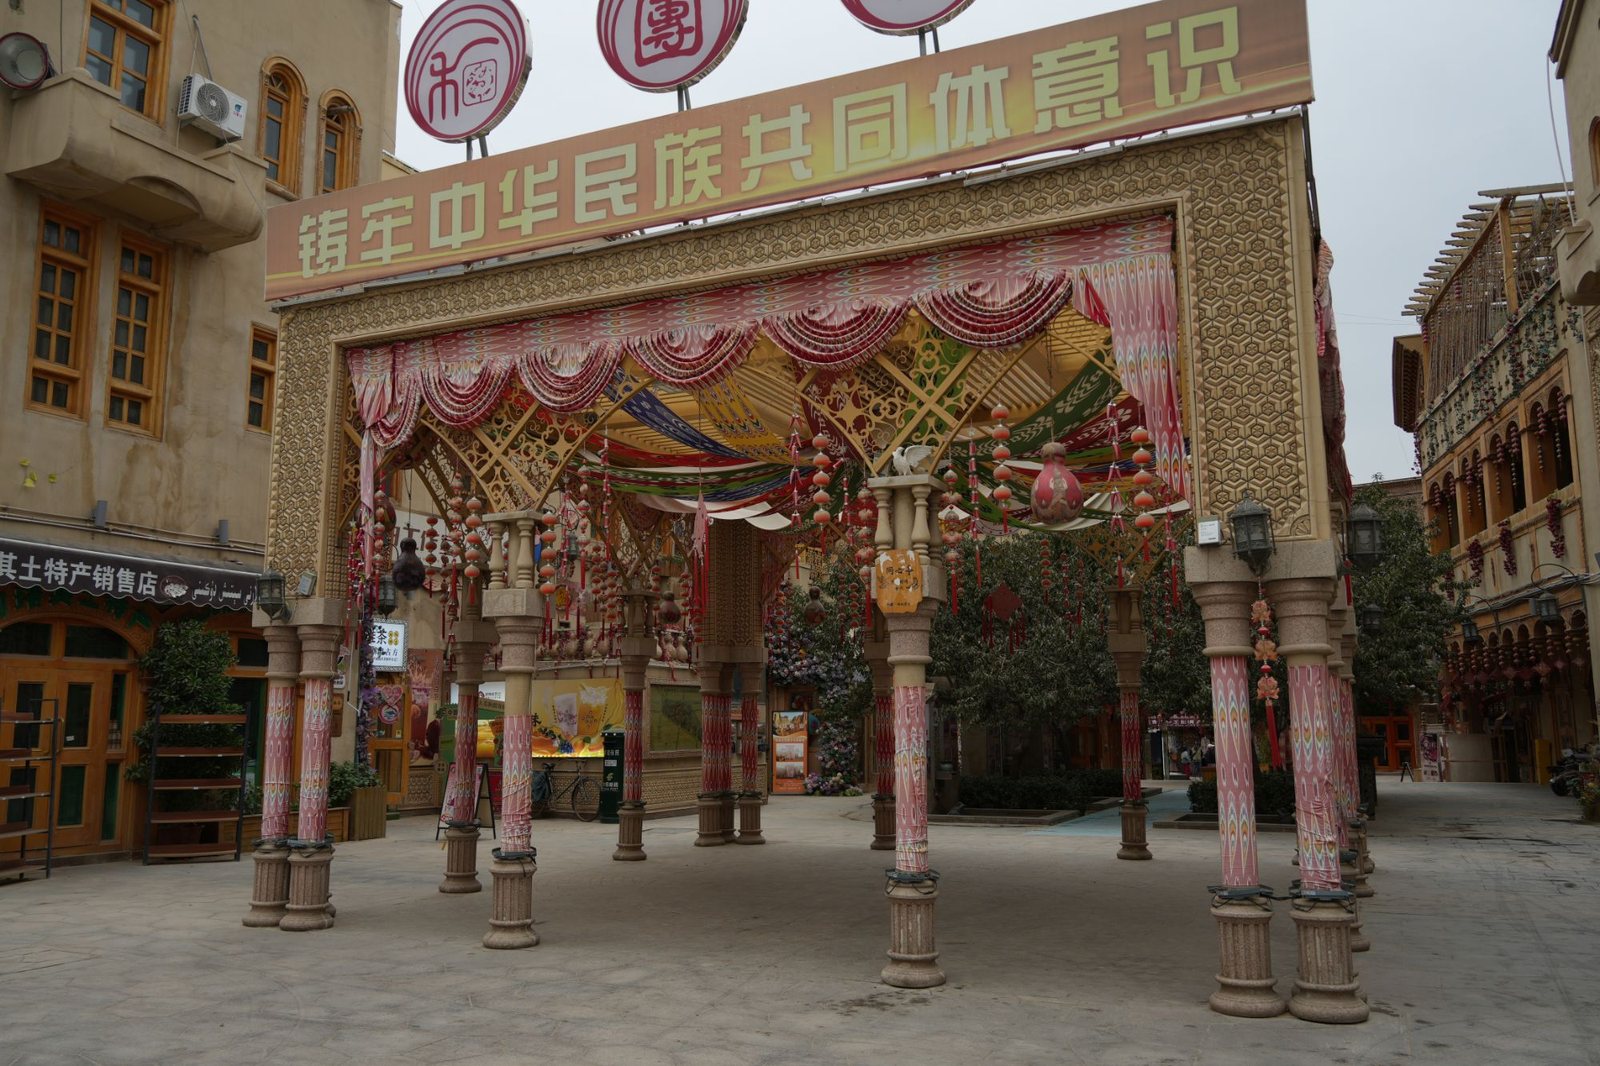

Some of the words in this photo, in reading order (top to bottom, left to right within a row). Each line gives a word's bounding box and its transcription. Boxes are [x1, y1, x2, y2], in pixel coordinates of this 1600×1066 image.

[298, 6, 1242, 279] 铸牢中华民族共同体意识
